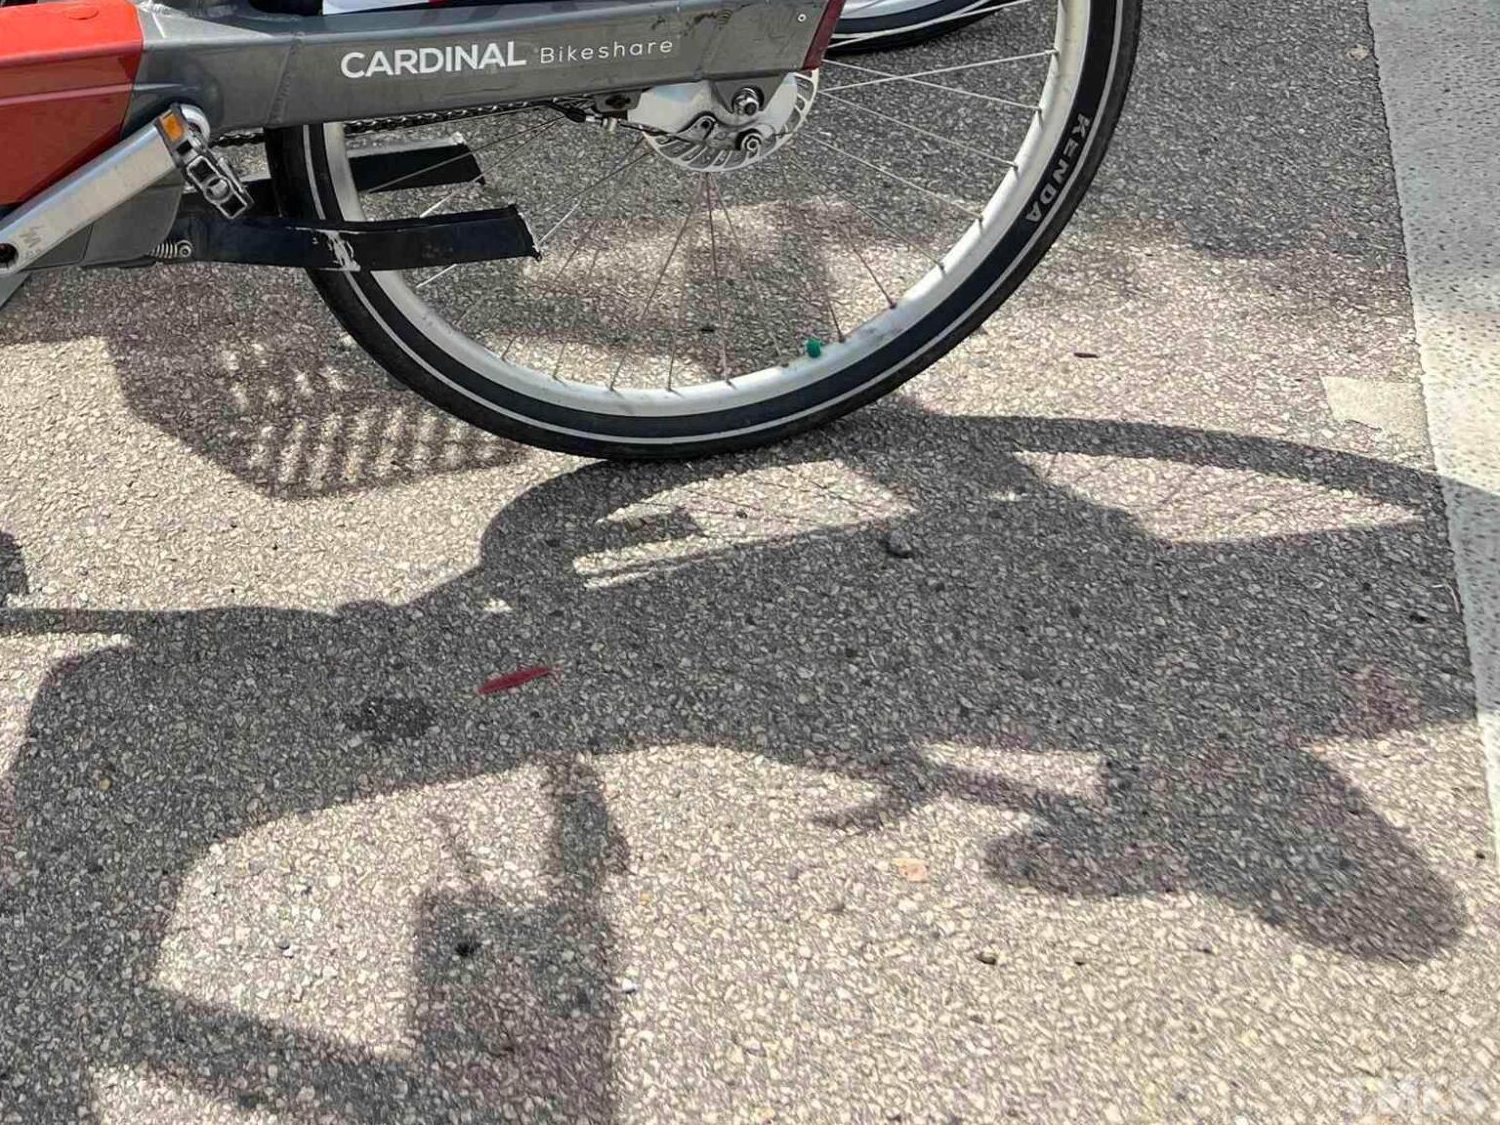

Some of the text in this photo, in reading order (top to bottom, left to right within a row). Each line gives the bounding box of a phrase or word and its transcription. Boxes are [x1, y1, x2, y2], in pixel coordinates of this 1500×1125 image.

[340, 39, 674, 78] CARDINAL Bikeshare
[1025, 113, 1091, 222] KENDA
